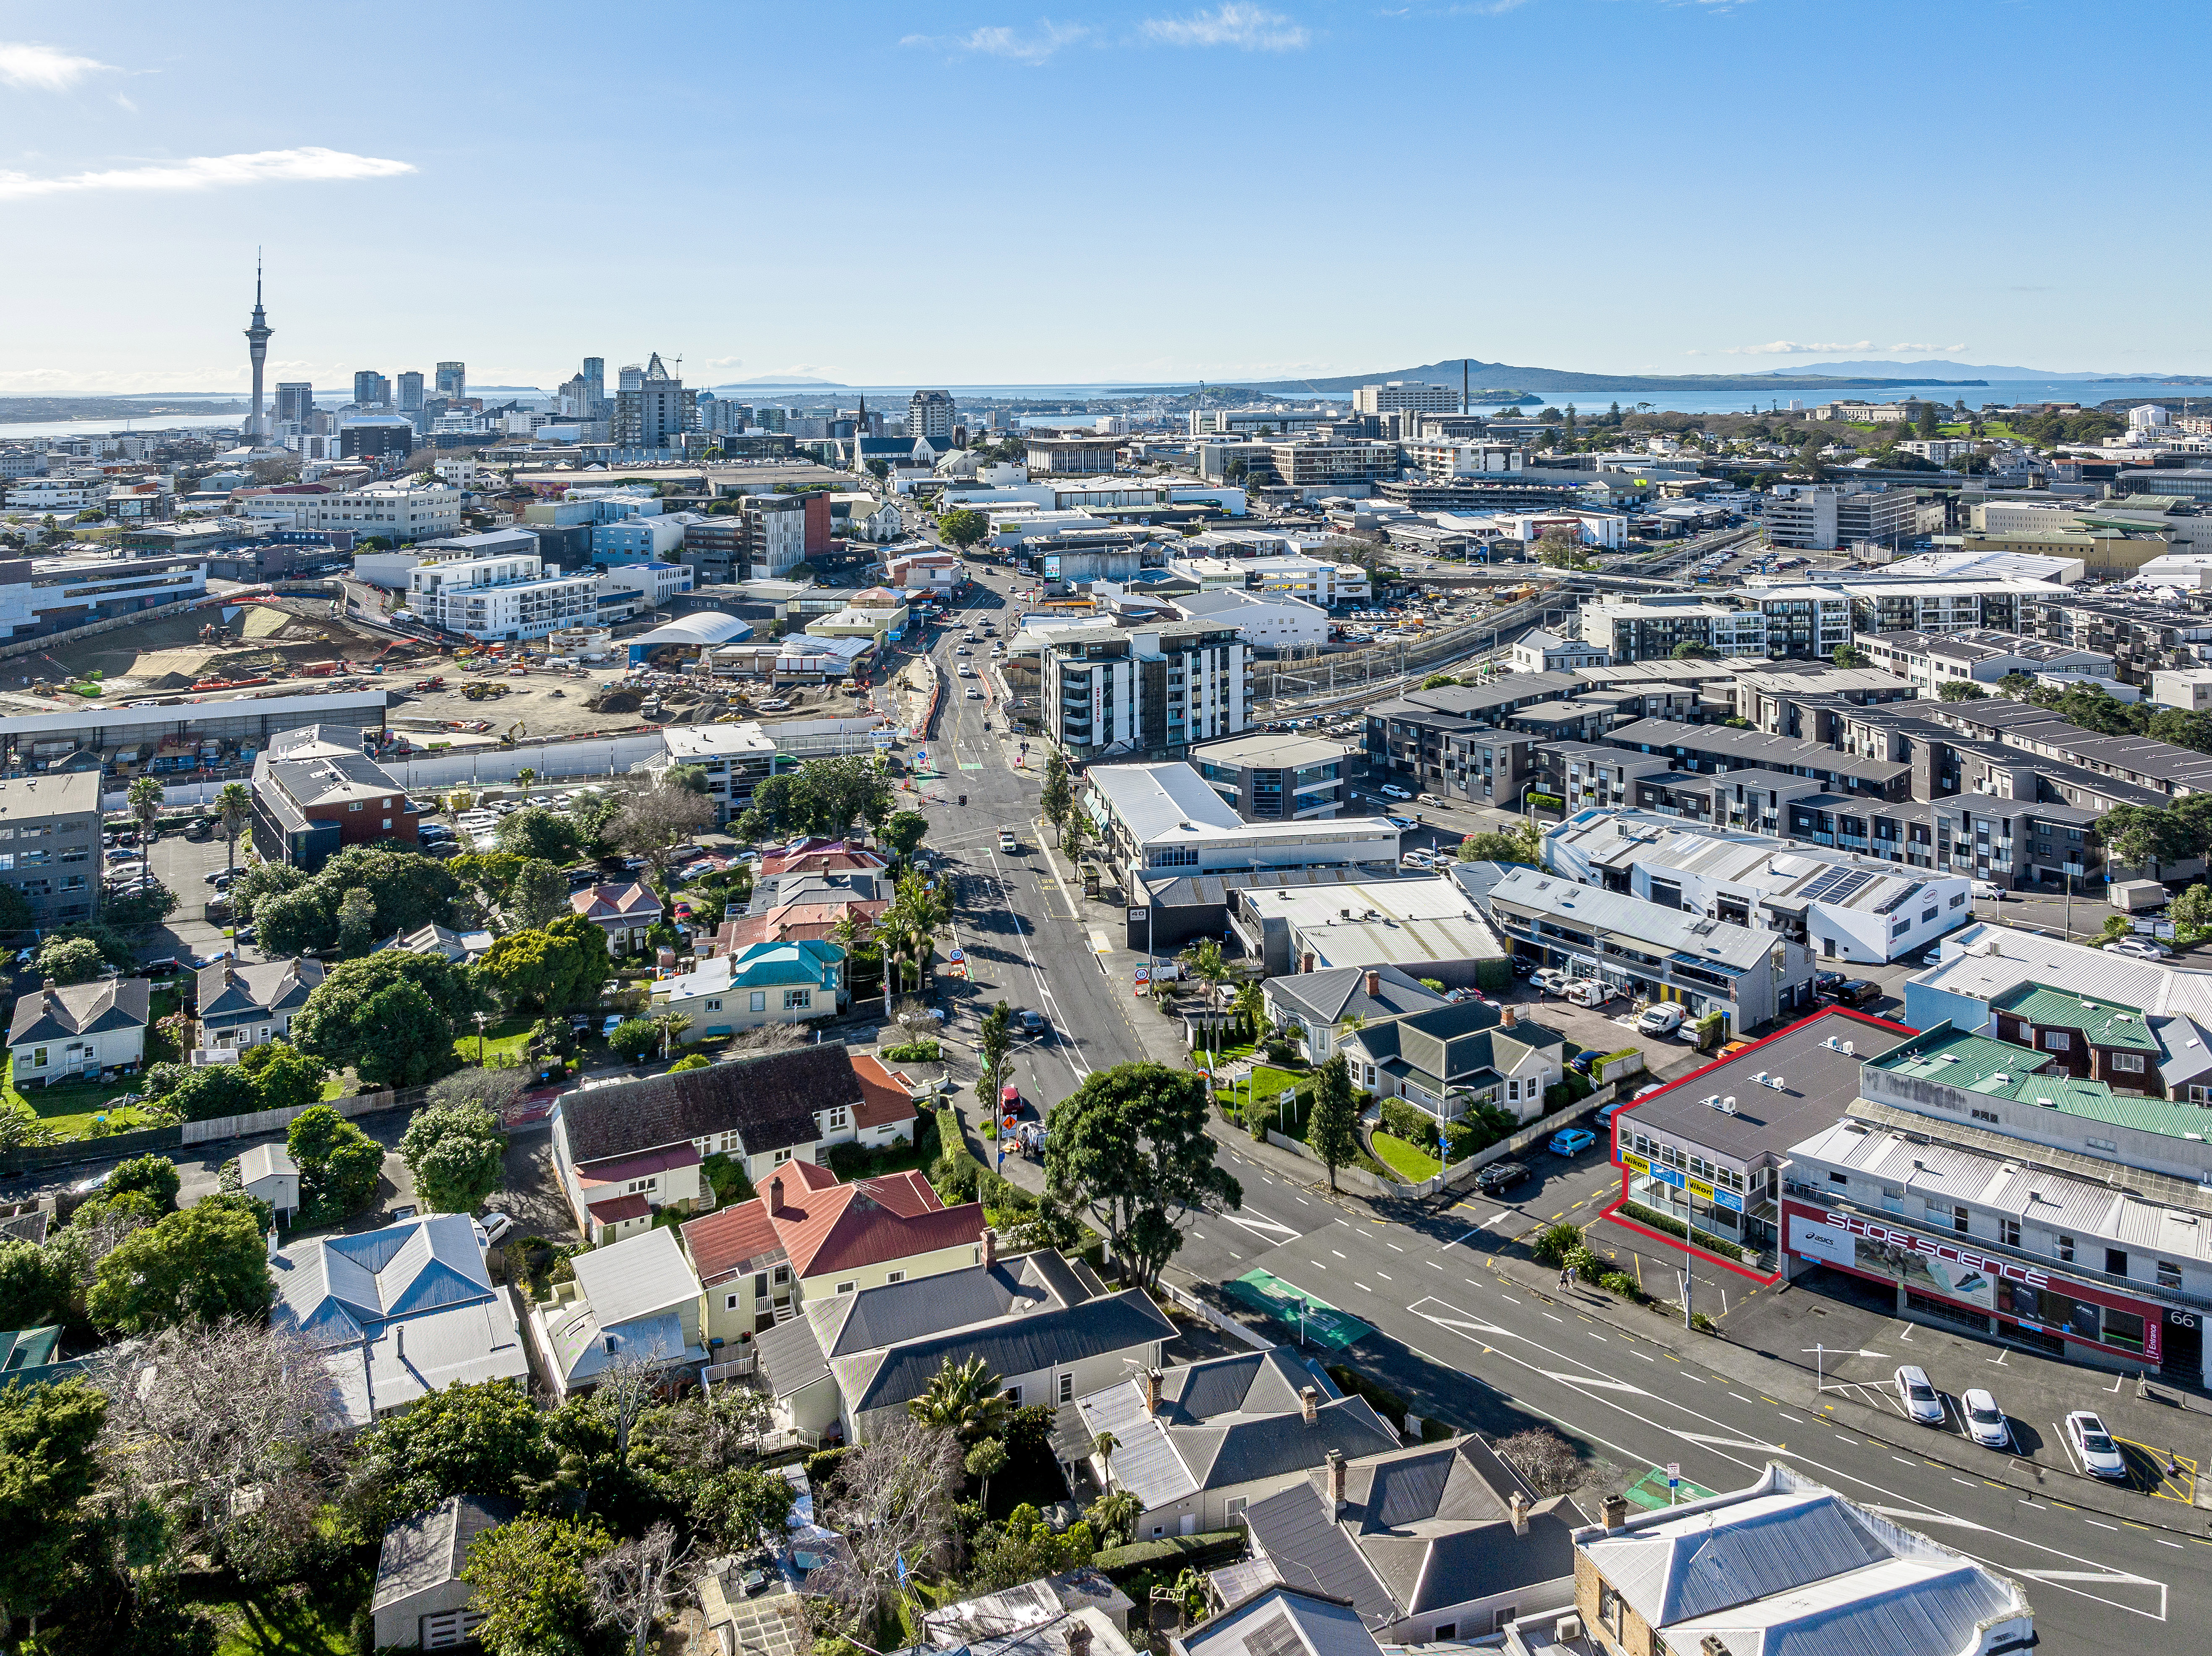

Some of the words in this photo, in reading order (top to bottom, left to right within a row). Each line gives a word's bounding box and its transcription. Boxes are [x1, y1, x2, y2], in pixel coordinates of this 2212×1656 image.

[1625, 1156, 1648, 1169] Nikon
[1688, 1182, 1712, 1195] Nikon
[1814, 1234, 1834, 1245] asics
[1826, 1213, 1908, 1247] SHOE
[1915, 1239, 2048, 1289] SCIENCE
[2171, 1312, 2194, 1327] 66
